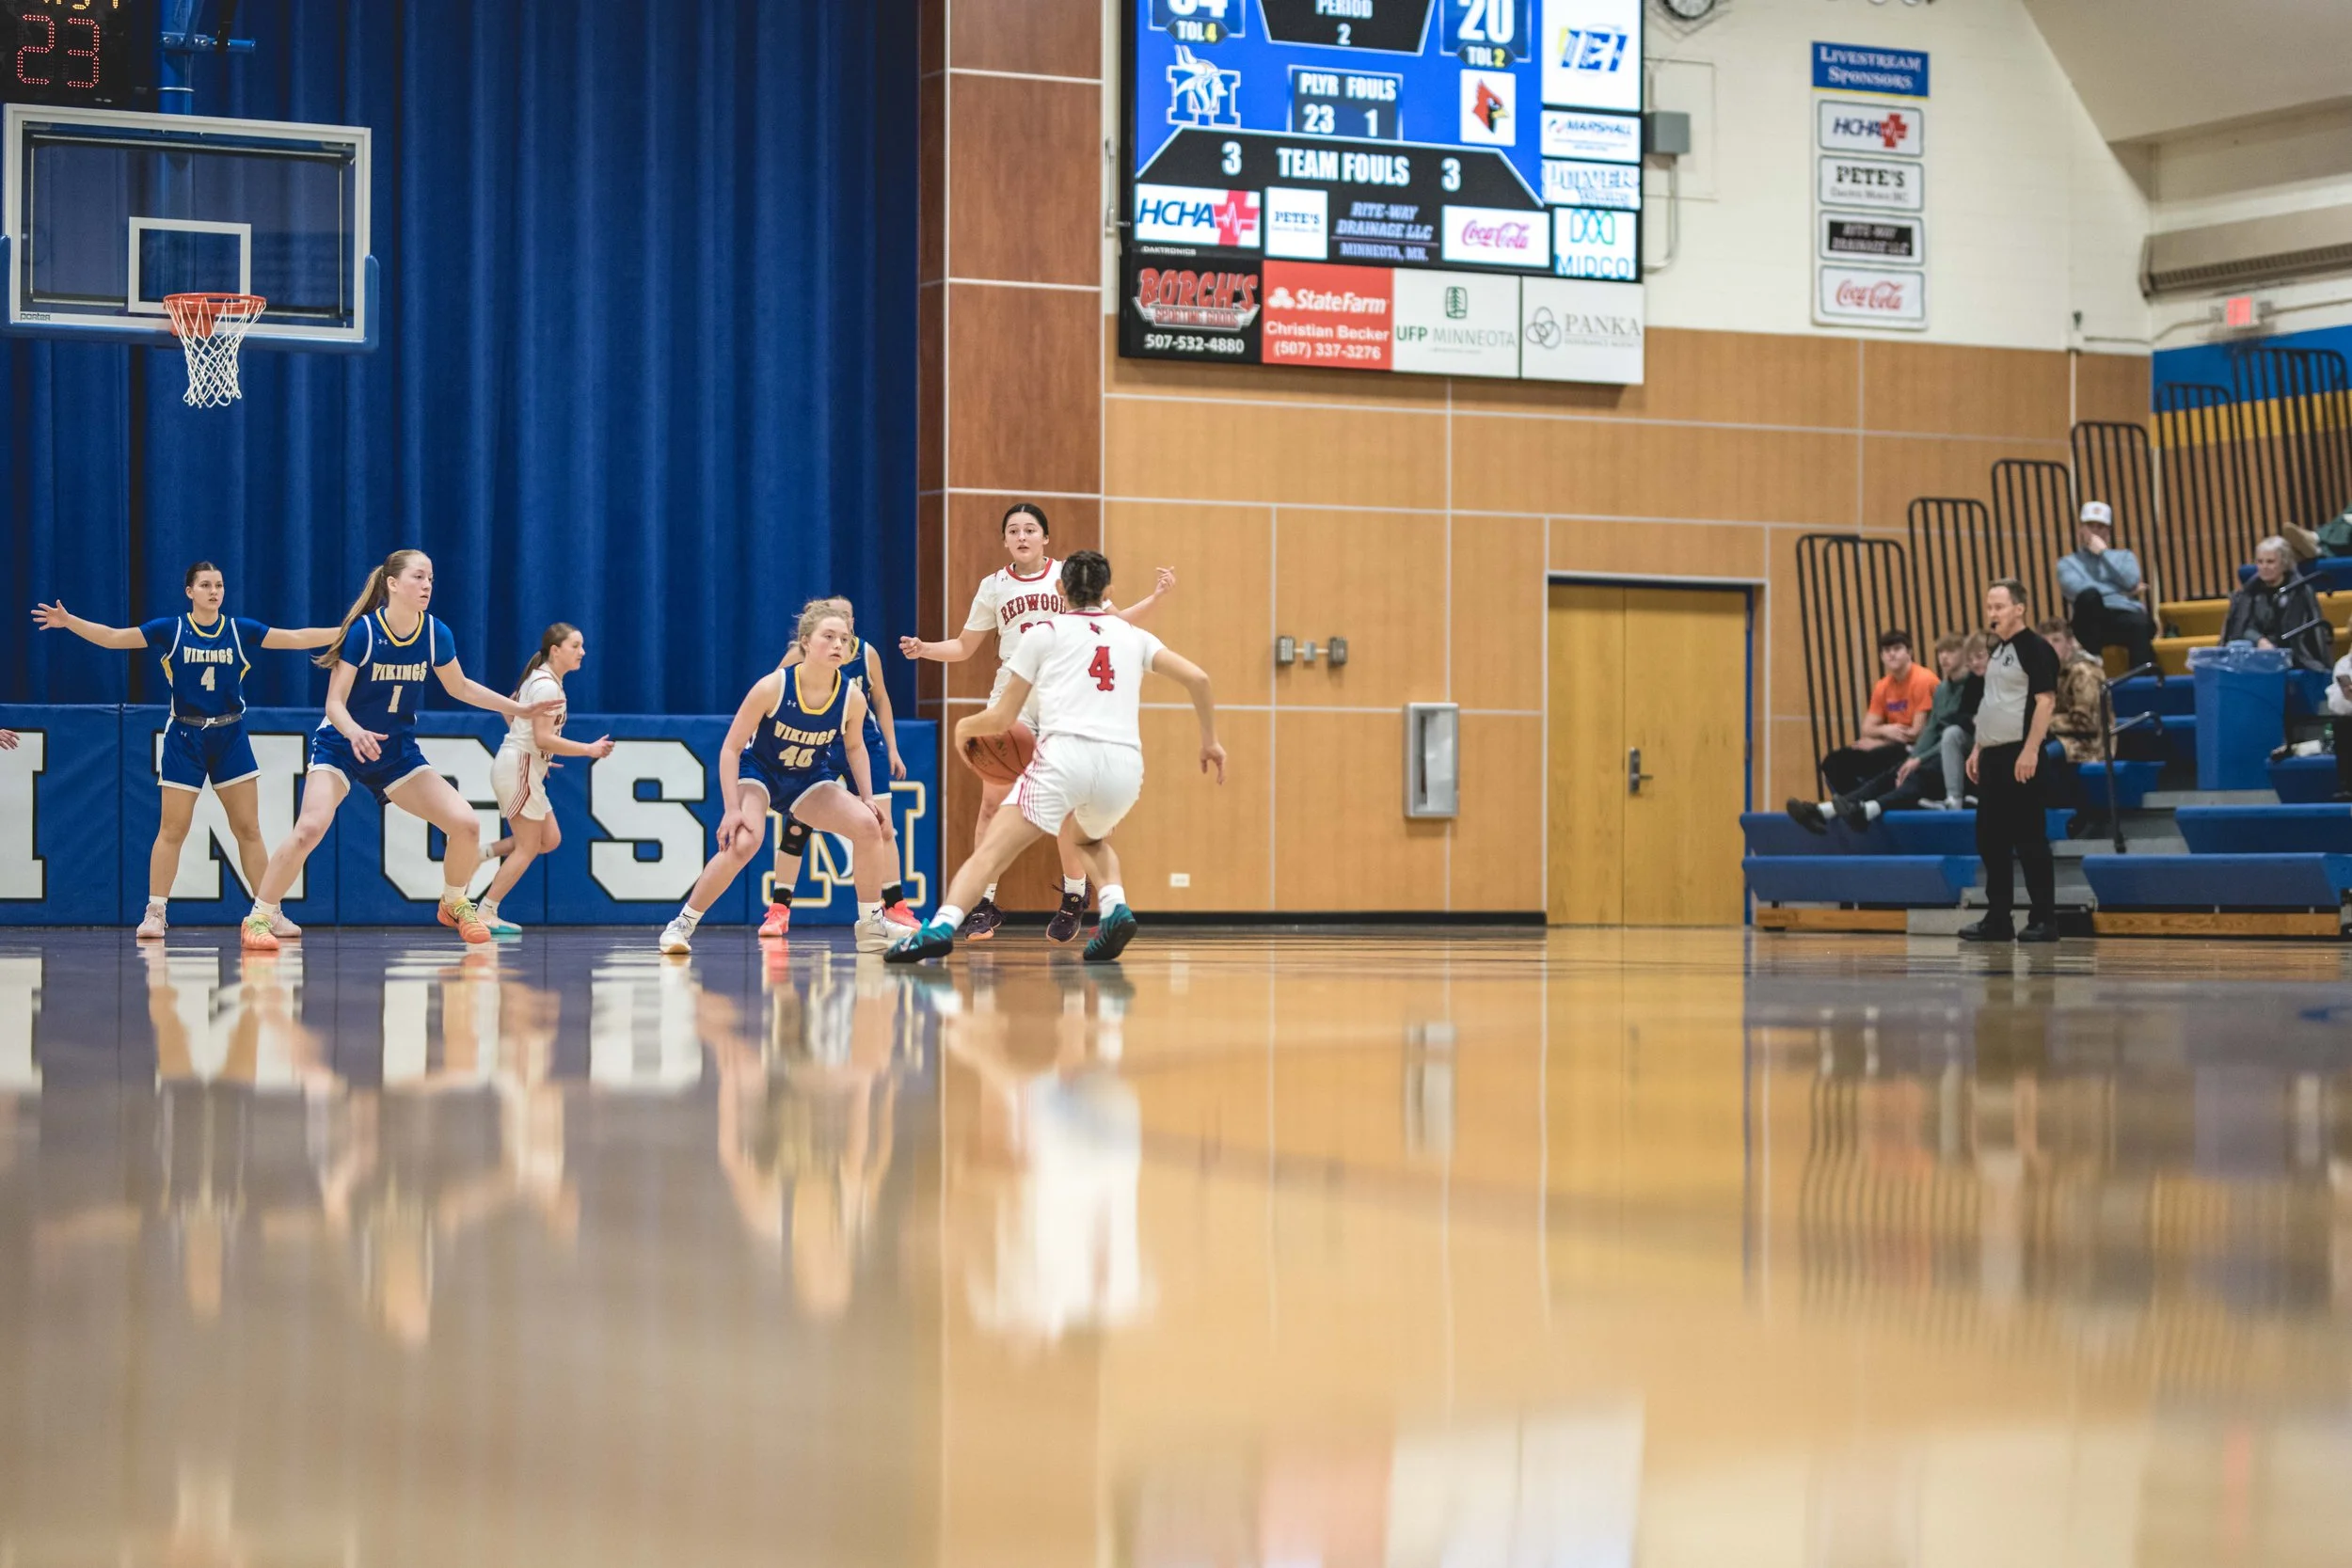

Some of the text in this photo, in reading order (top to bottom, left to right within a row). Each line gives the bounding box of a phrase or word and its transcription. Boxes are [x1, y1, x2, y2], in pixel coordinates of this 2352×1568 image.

[1316, 0, 1374, 19] PERIOD
[1176, 20, 1218, 43] TOL 4
[1458, 0, 1515, 43] 20
[1337, 23, 1351, 45] 2
[17, 14, 100, 88] 23
[1468, 45, 1506, 68] TOL 2
[1299, 72, 1397, 102] PLYR FOULS
[1302, 103, 1378, 137] 23 1
[1834, 118, 1882, 137] HCHA
[1222, 141, 1462, 192] 3 TEAM FOULS 3
[1836, 166, 1905, 187] PETE'S
[1136, 198, 1216, 230] HCHA
[1274, 211, 1321, 225] PETE'S
[1350, 201, 1419, 221] RITE-WAY
[1336, 219, 1405, 238] DRAINAGE
[1405, 225, 1435, 241] LLC
[1554, 254, 1630, 280] MIDCO
[1139, 267, 1259, 313] BORCH'S
[1265, 321, 1391, 341] Christian Becker
[1565, 313, 1641, 337] PANKA
[1145, 333, 1245, 355] 507-532-4880
[1396, 325, 1518, 349] UFP MINNEOTA
[1274, 340, 1382, 360] (507) 337-3276
[183, 647, 233, 664] VIKINGS
[200, 666, 215, 690] 4
[371, 661, 427, 682] VIKINGS
[1089, 646, 1114, 691] 4
[387, 686, 403, 713] 1
[774, 721, 836, 745] VIKINGS
[778, 745, 816, 768] 40
